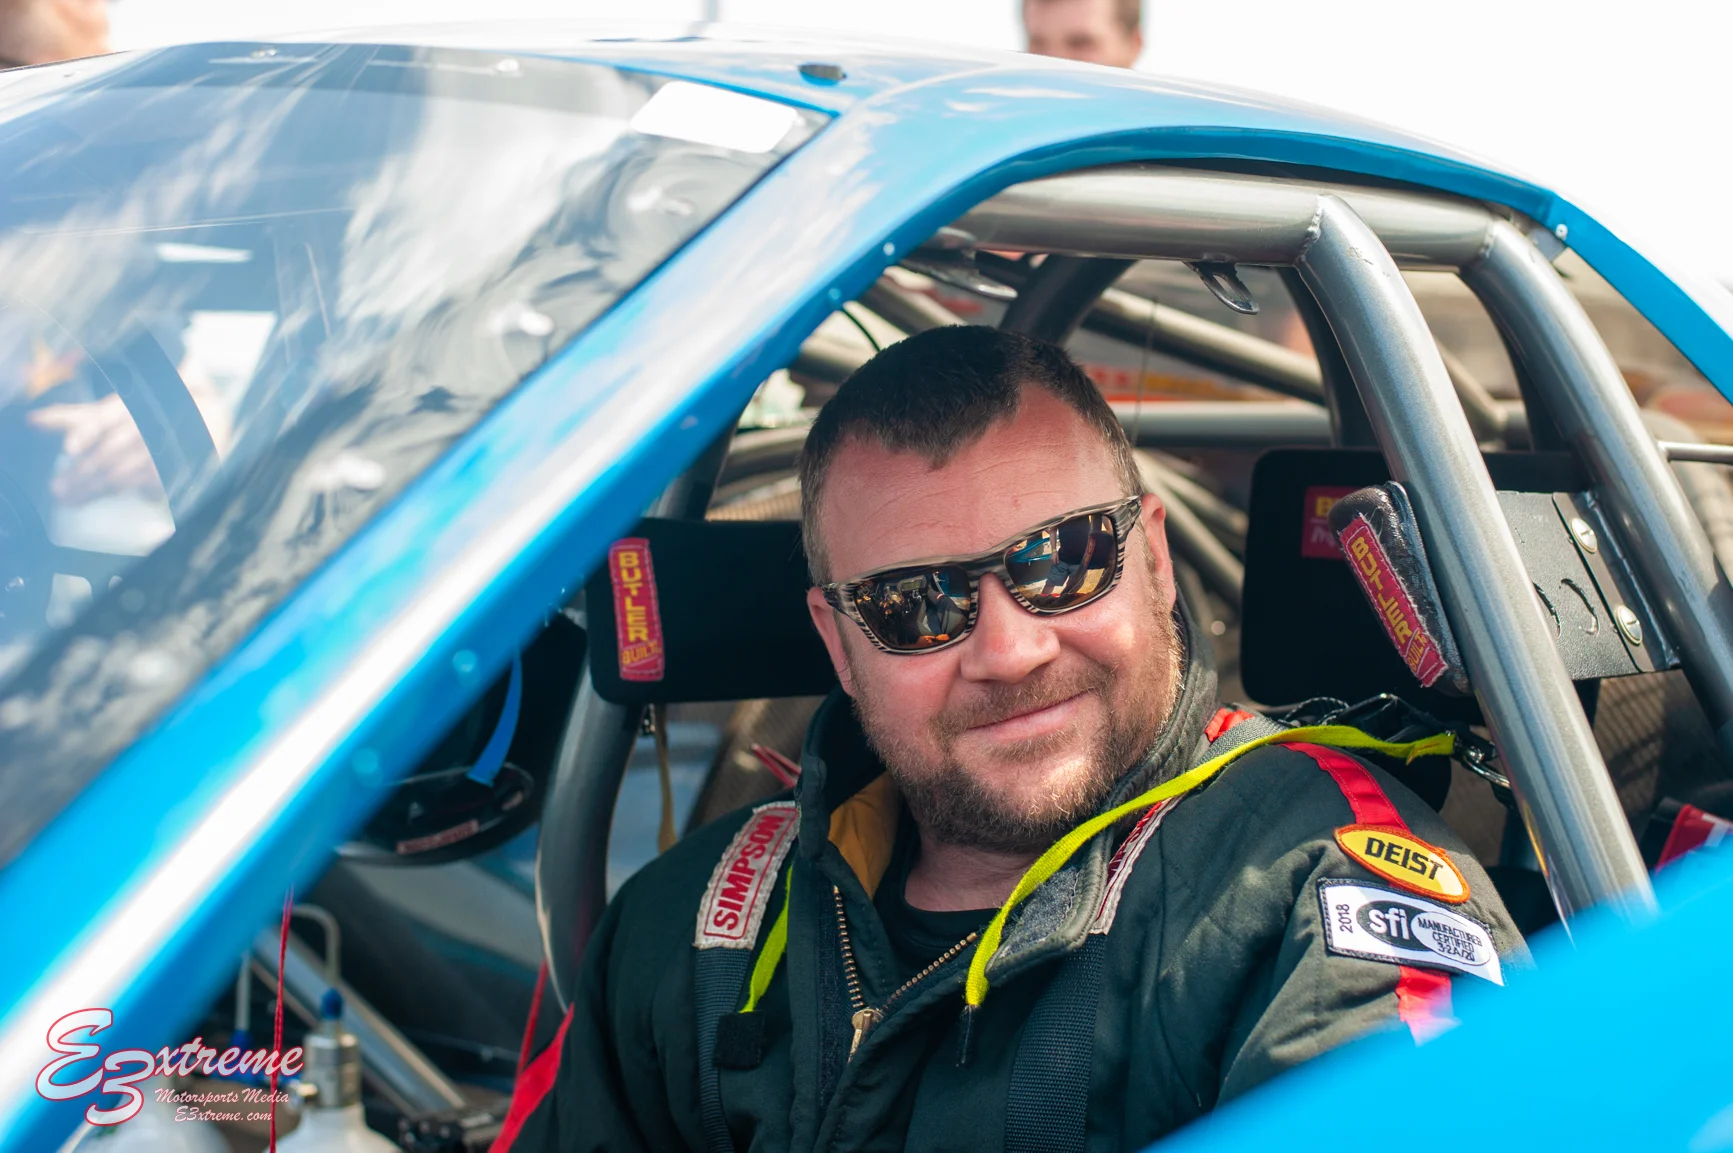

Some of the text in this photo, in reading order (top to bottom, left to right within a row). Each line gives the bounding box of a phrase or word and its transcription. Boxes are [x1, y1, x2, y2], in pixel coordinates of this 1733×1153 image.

[619, 552, 649, 643] BUTLER
[1351, 536, 1413, 644] BUTLER
[713, 815, 787, 931] SIMPSON
[1365, 836, 1443, 880] DEIST
[1336, 904, 1354, 934] 2018
[1368, 907, 1410, 940] sfi
[1432, 931, 1475, 953] CERTIFIED
